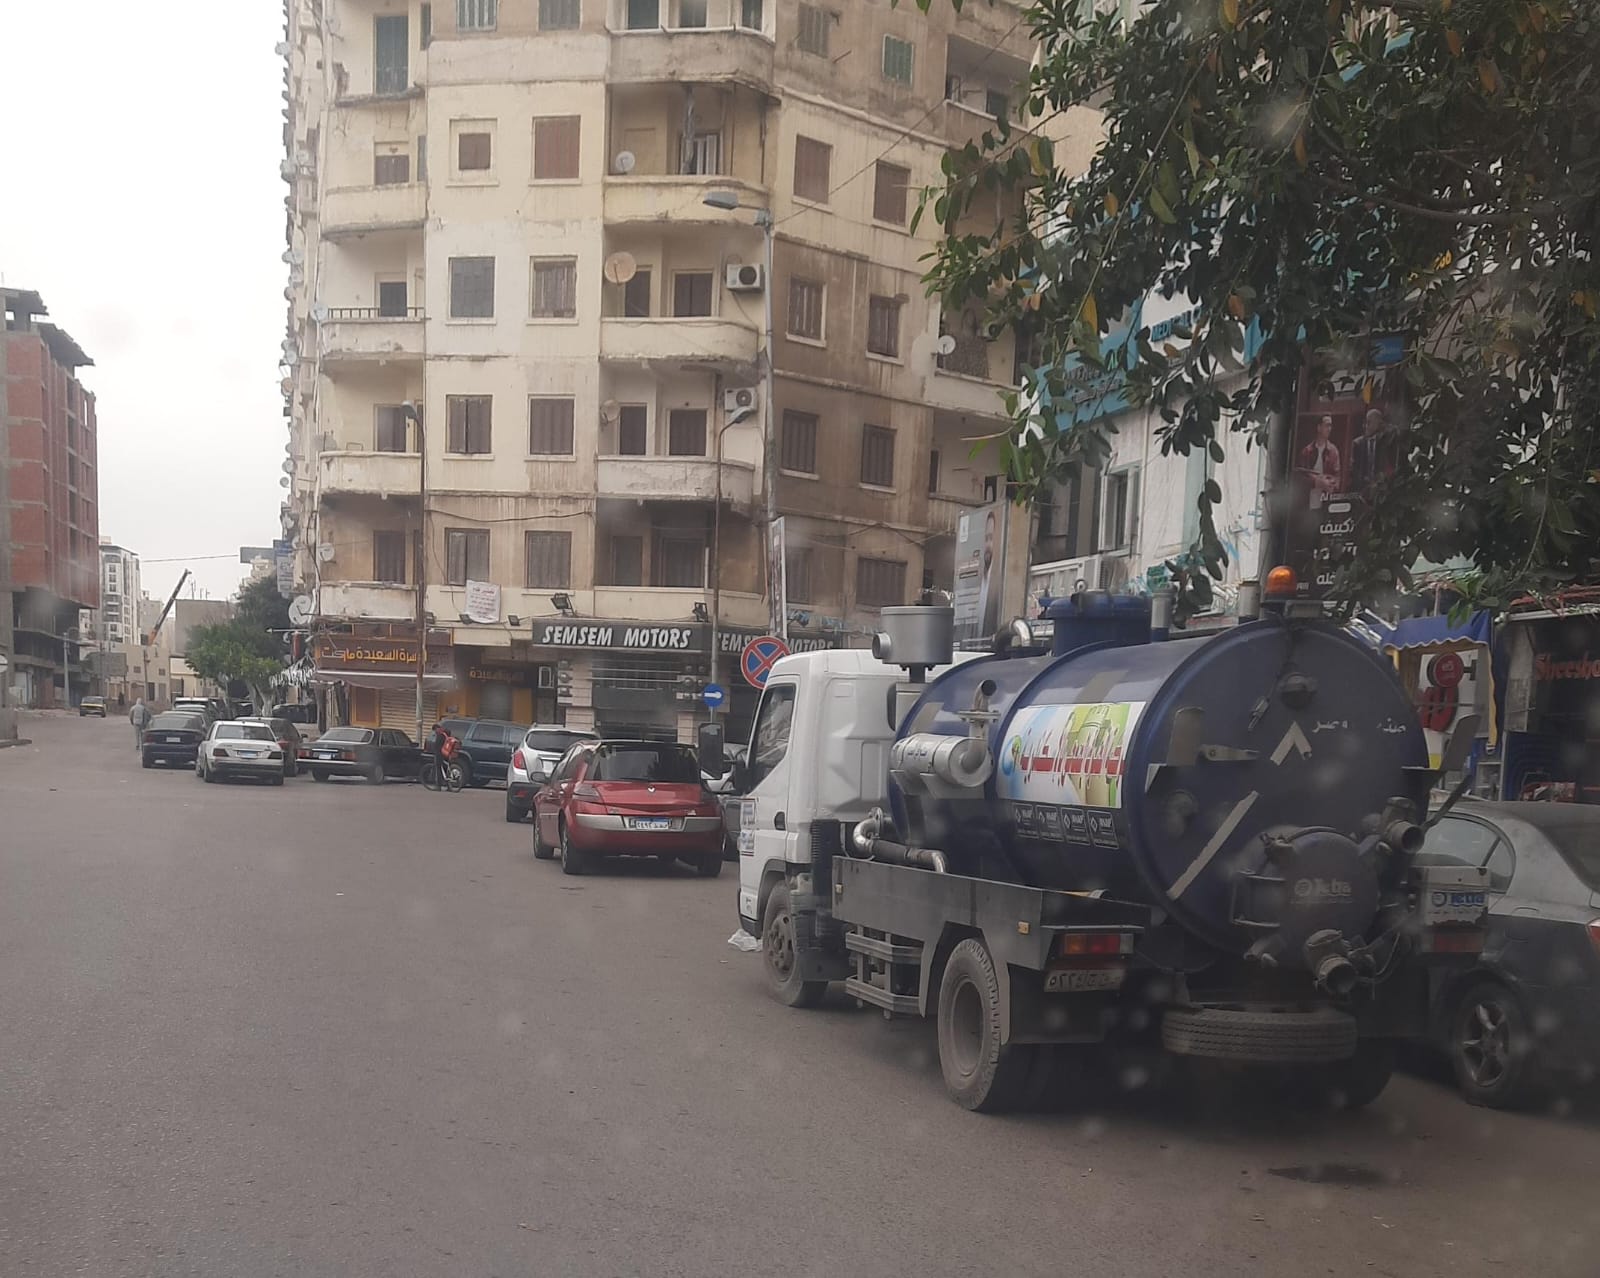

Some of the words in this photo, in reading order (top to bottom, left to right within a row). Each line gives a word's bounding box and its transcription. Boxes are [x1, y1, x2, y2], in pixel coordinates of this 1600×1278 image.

[542, 625, 613, 646] SEMSEM
[623, 627, 691, 648] MOTORS
[355, 646, 398, 664] السعيدة
